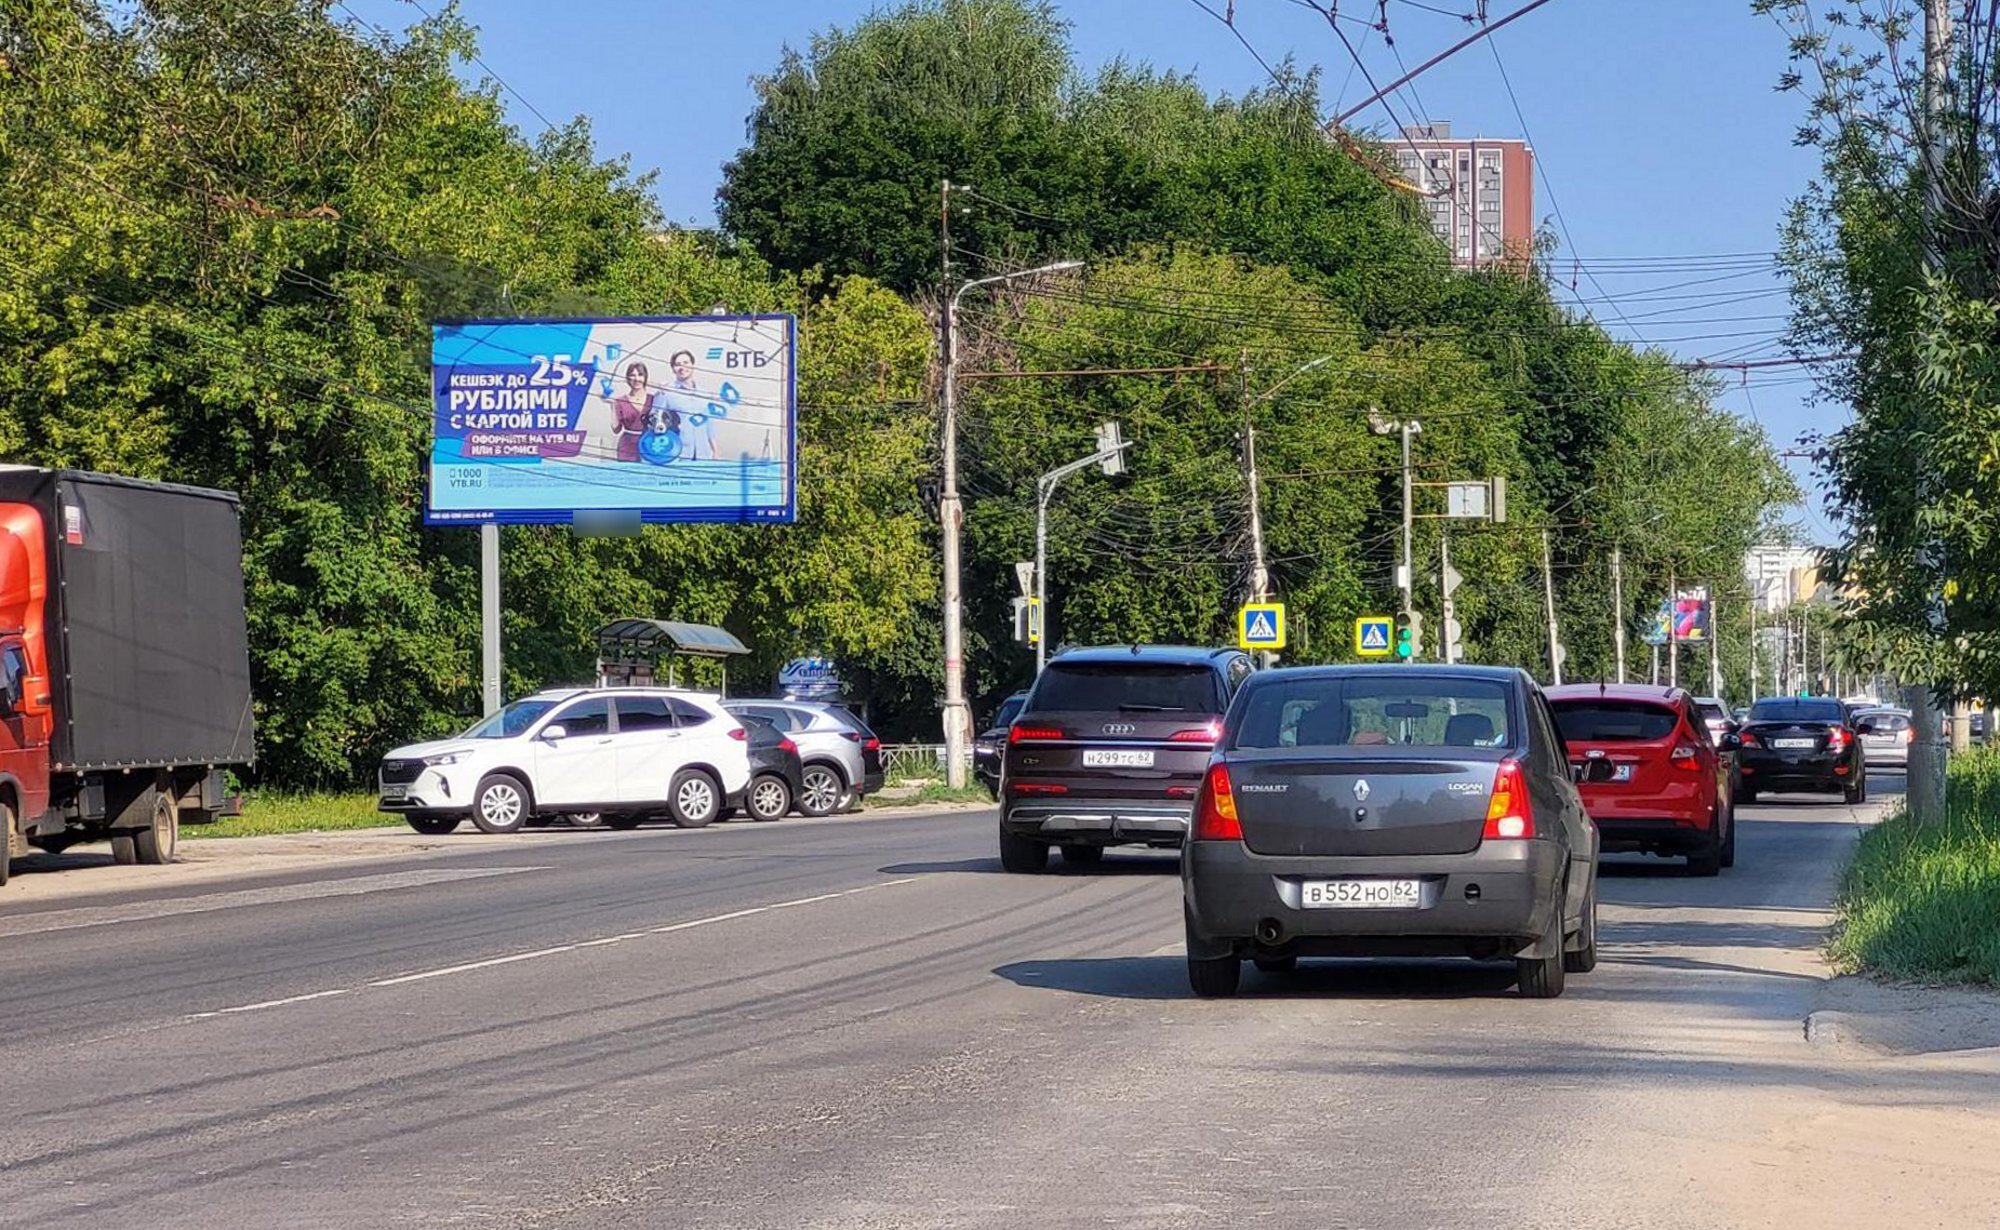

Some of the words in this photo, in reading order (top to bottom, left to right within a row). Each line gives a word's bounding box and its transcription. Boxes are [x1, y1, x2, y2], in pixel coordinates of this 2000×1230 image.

[726, 351, 766, 369] ВТБ
[450, 375, 503, 387] КЕШБЭК
[507, 375, 527, 388] ДО
[530, 354, 588, 387] 25%
[450, 389, 568, 411] РУБЛЯМИ
[450, 413, 463, 429] С
[466, 410, 533, 429] КАРТОЙ
[537, 413, 567, 428] ВТБ
[458, 468, 482, 478] 1000
[1448, 783, 1483, 791] LOGAN
